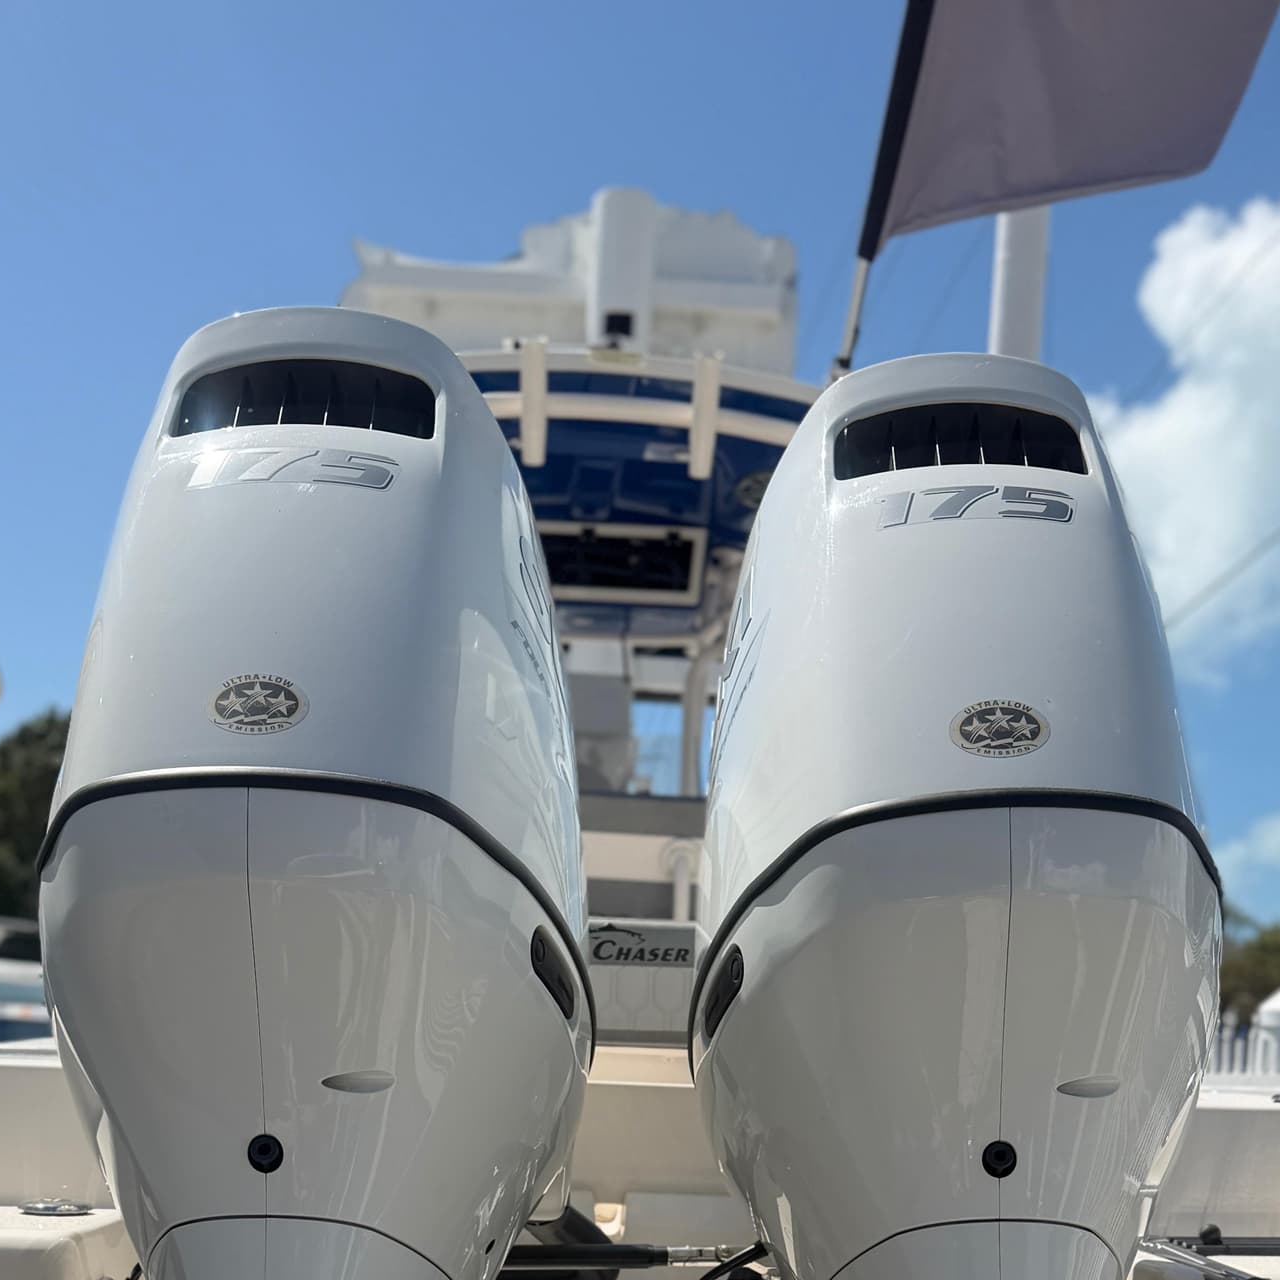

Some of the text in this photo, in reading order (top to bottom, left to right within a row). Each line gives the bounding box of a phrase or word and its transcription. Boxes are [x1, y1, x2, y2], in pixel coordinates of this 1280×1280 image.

[186, 449, 400, 491] 175
[881, 485, 1074, 529] 175
[222, 674, 294, 689] ULTRA LOW
[963, 700, 1033, 715] ULTRA LOW
[228, 724, 284, 733] EMISSION
[976, 746, 1031, 756] EMISSION
[592, 940, 690, 962] CHASER
